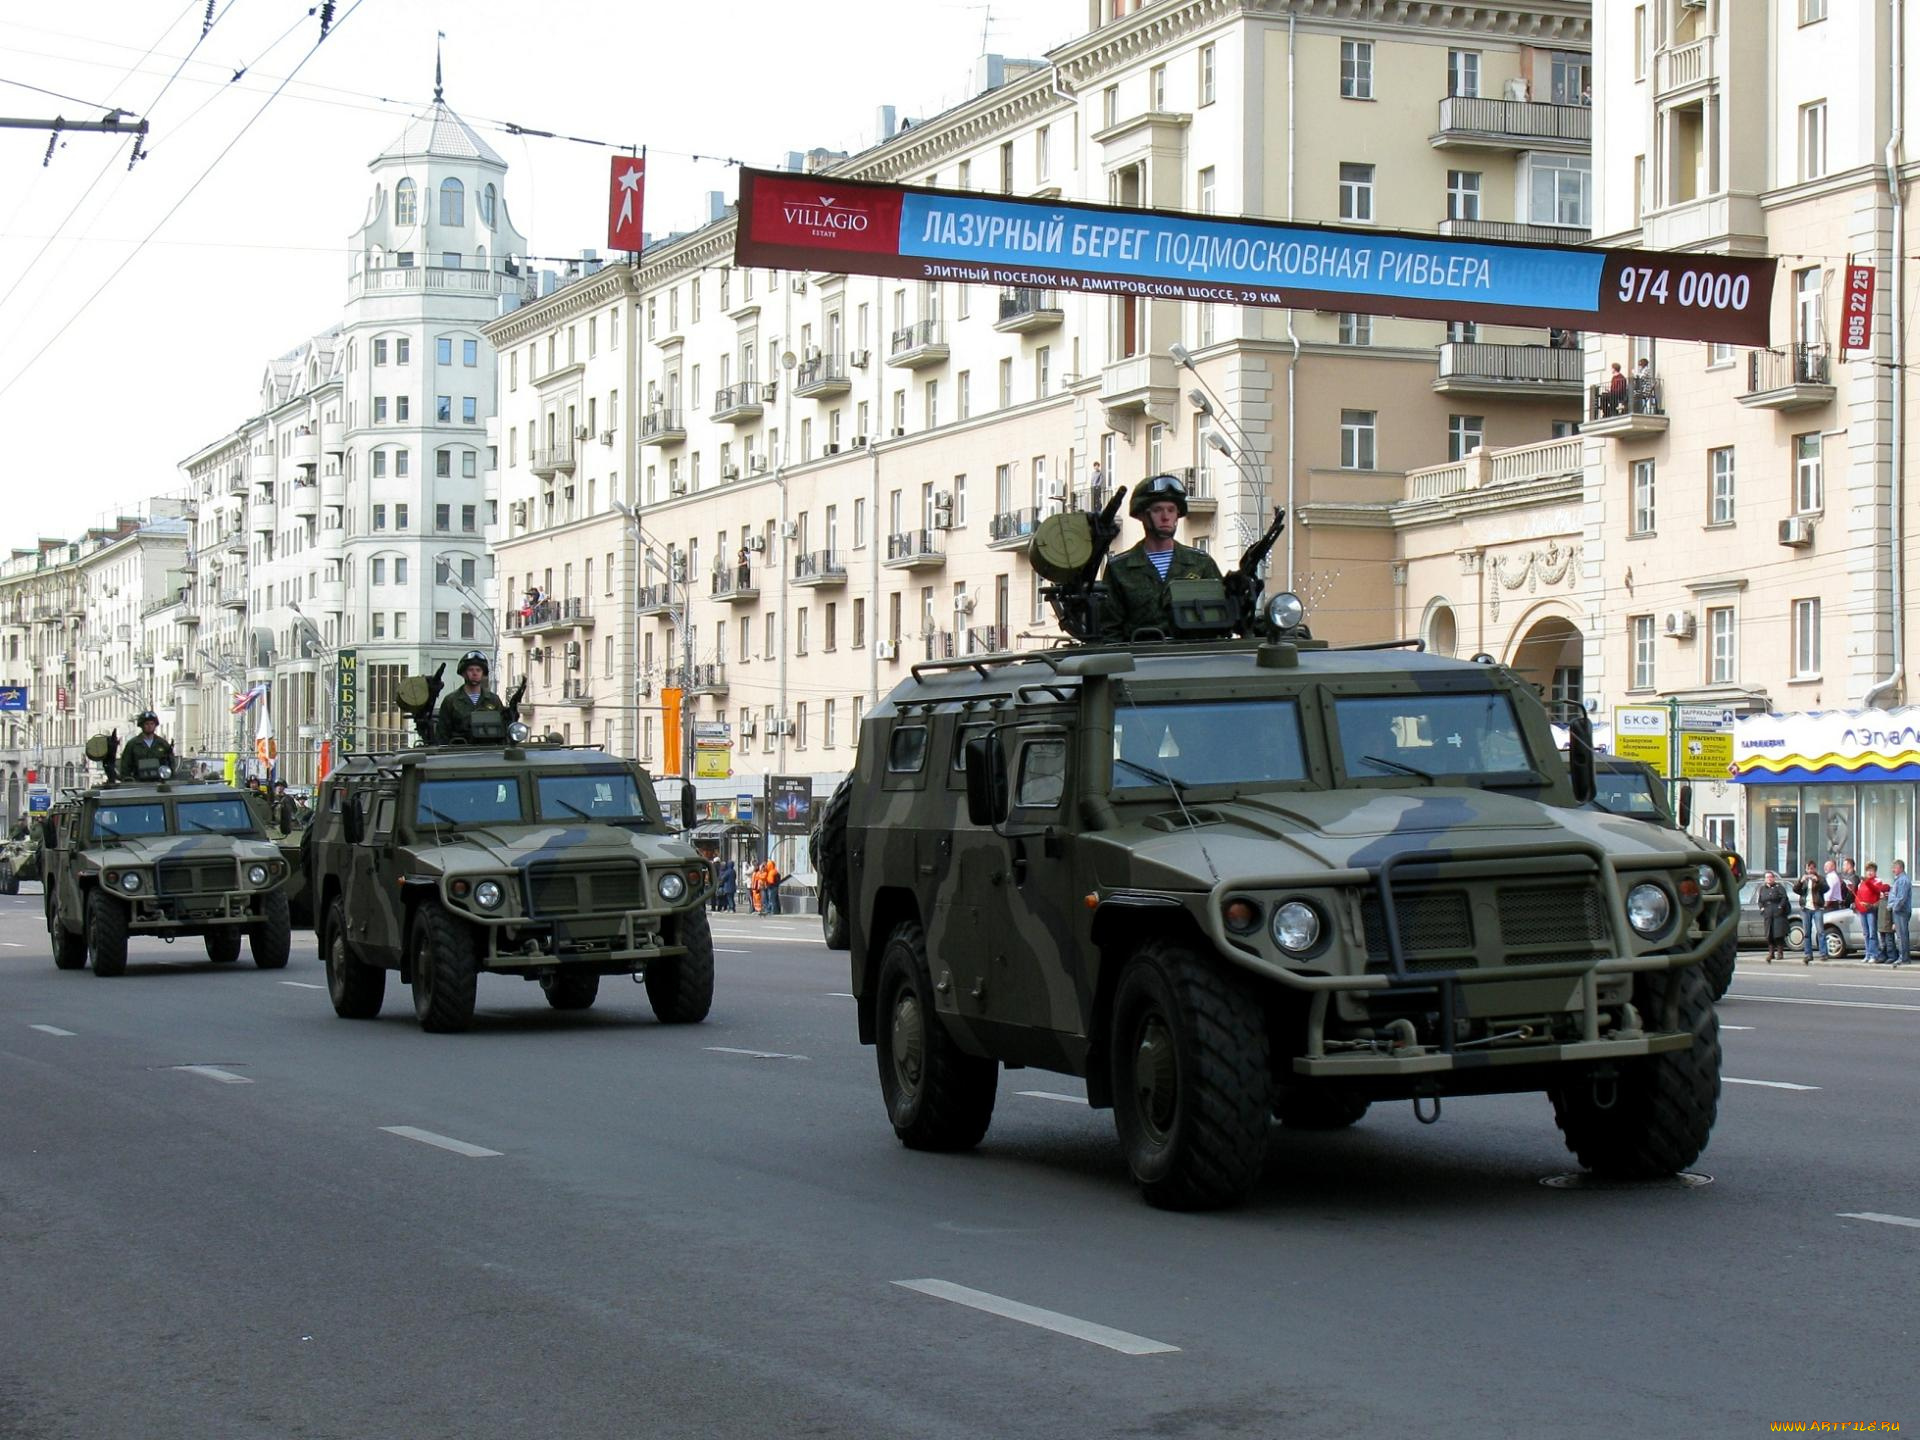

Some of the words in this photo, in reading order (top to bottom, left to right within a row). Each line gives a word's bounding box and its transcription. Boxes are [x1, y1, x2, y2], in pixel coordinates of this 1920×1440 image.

[783, 207, 868, 231] VILLAGIO
[811, 229, 837, 238] ESTATE
[922, 210, 1065, 254] ЛАЗУРНЫЙ
[1071, 223, 1150, 261] БЕРЕГ
[1155, 231, 1371, 280] ПОДМОСКОВНАЯ
[1378, 250, 1490, 289] РИВЬЕРА
[923, 264, 990, 281] ЭЛИТНЫЙ
[994, 271, 1057, 286] ПОСЕЛОК
[1060, 276, 1079, 288] НА
[1081, 277, 1185, 297] ДМИТРОВСКОМ
[1187, 287, 1239, 302] ШОССЕ,
[1241, 291, 1257, 302] 29
[1261, 292, 1282, 304] КМ
[1618, 266, 1670, 305] 974
[1678, 270, 1750, 311] 0000
[1852, 269, 1869, 290] 25
[1850, 292, 1867, 313] 22
[1847, 315, 1866, 346] 995
